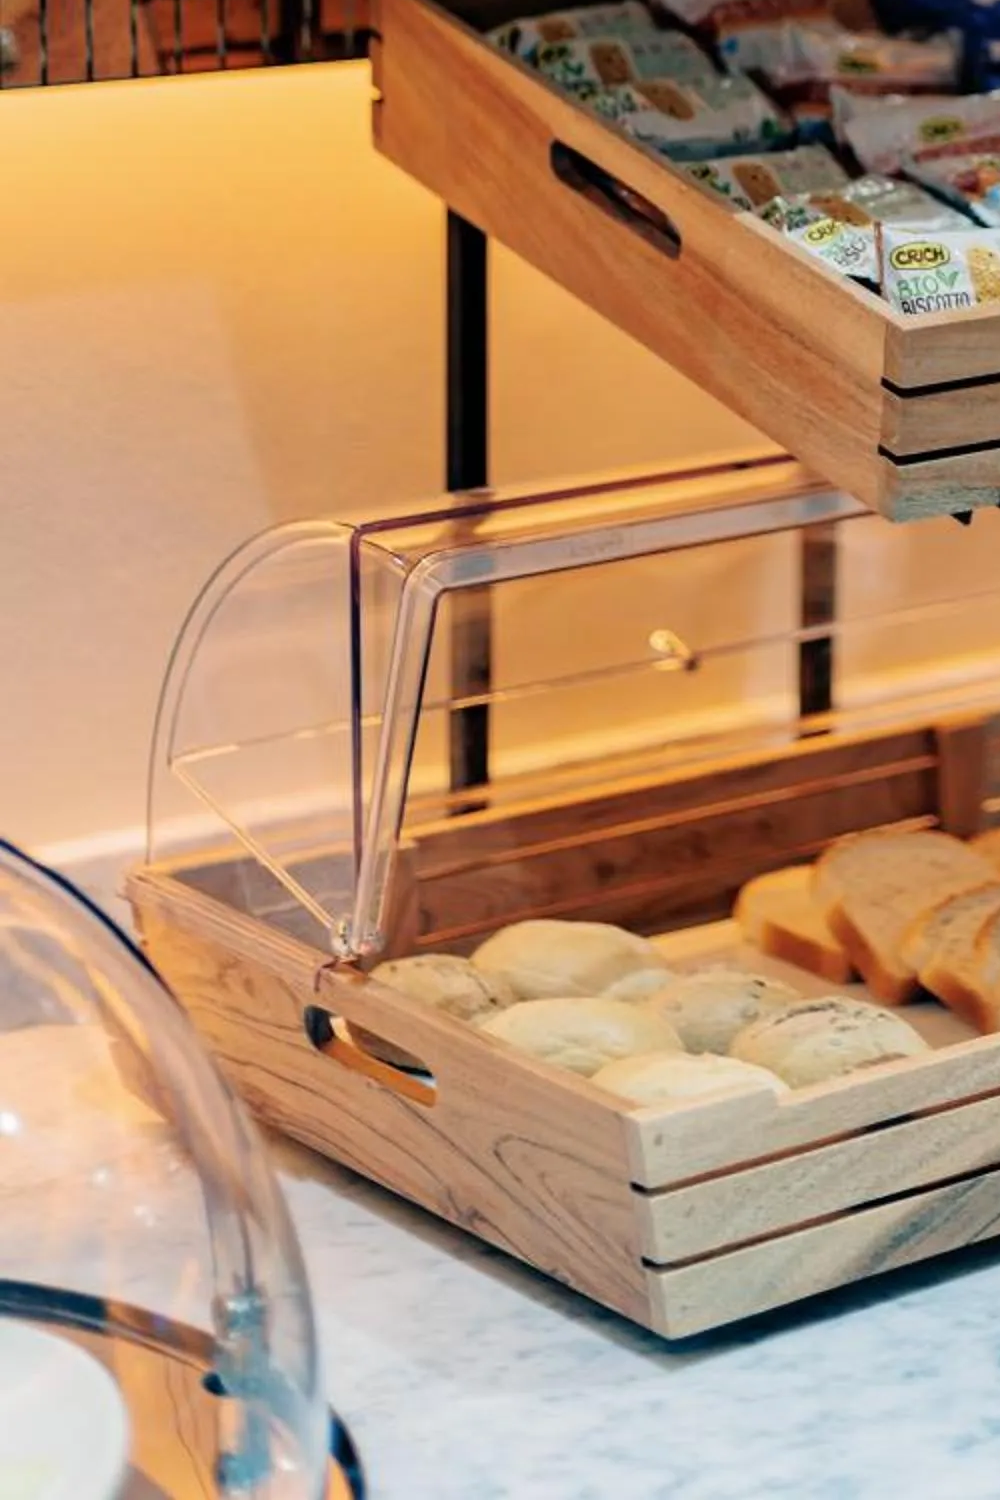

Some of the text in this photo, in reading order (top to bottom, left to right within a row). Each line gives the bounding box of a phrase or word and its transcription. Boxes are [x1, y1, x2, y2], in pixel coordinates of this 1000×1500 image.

[896, 244, 945, 265] CRICH
[896, 273, 939, 300] BIO
[901, 291, 971, 315] BISCOTTO
